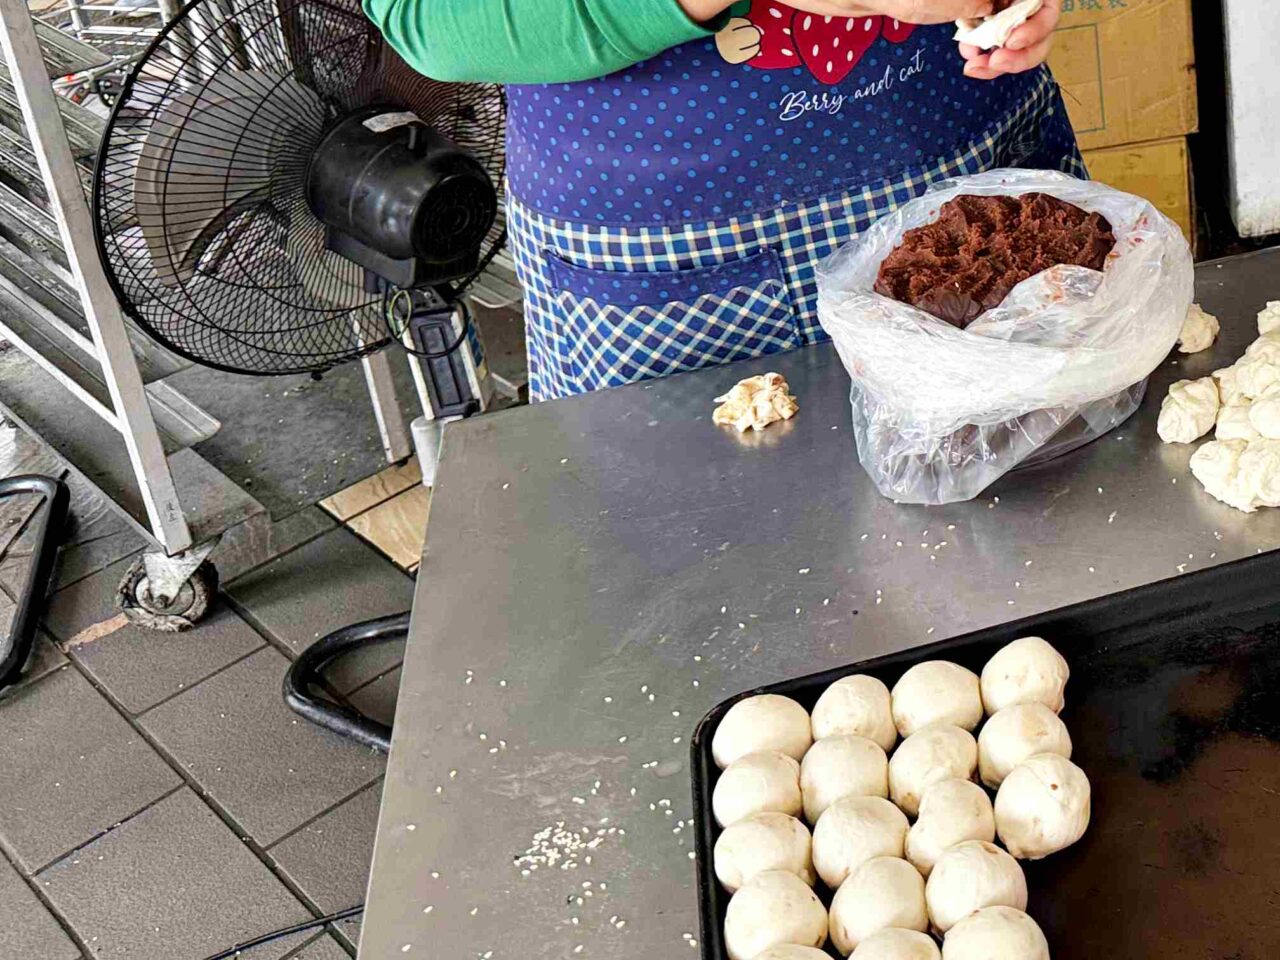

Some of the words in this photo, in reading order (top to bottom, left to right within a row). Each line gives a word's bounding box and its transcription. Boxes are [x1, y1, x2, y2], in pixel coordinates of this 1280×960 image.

[779, 90, 848, 122] Berry
[854, 64, 894, 100] and
[899, 47, 927, 82] cat
